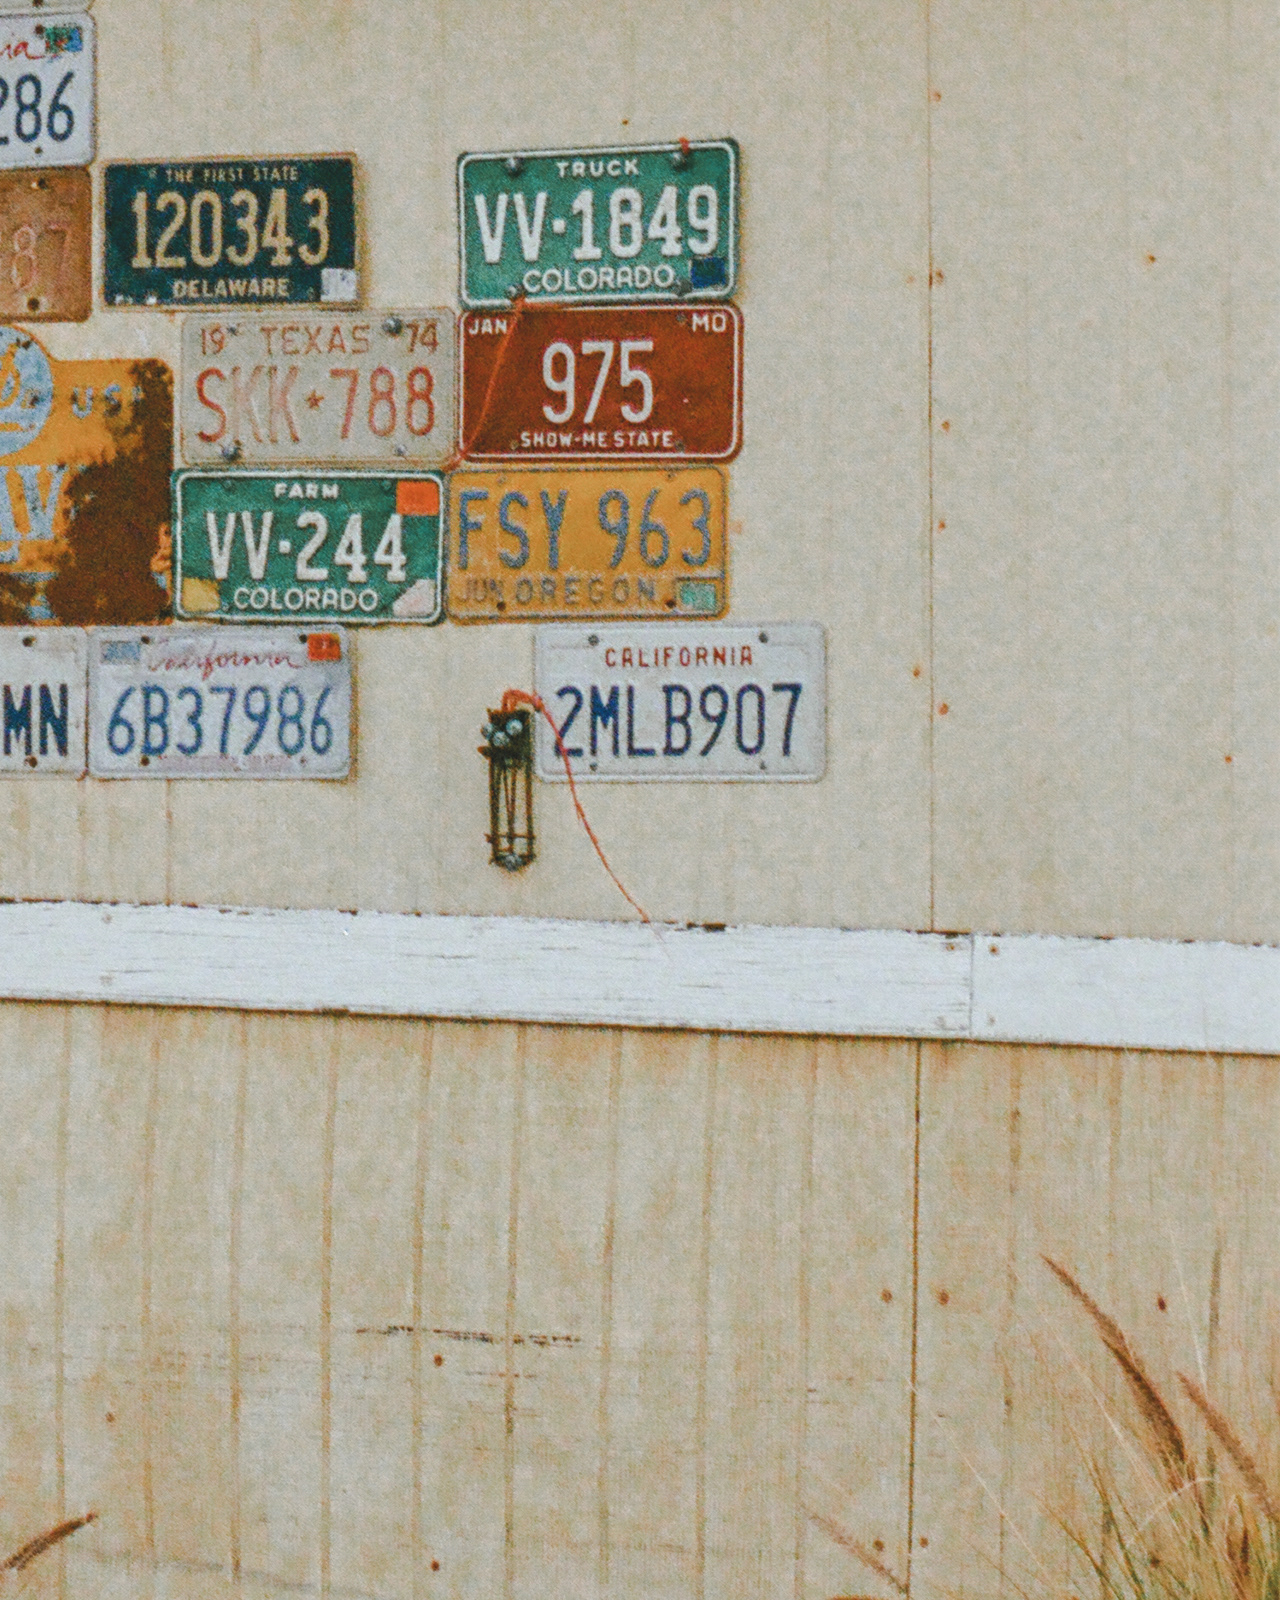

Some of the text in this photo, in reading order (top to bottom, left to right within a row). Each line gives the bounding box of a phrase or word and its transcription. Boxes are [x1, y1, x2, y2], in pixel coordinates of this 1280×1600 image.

[166, 166, 300, 184] THE FIRST STATE
[557, 157, 640, 179] TRUCK
[130, 186, 331, 269] 120343
[172, 277, 290, 299] DELAWARE
[522, 263, 676, 293] COLORADO
[199, 322, 440, 356] 19 TEXAS 74
[468, 312, 728, 336] JAN MO
[541, 338, 655, 426] 975
[194, 364, 437, 445] SKK 788
[520, 430, 675, 450] SHOW-ME STATE
[274, 482, 340, 500] FARM
[457, 487, 714, 571] FSY 963
[232, 587, 379, 612] COLORADO
[514, 575, 658, 606] OREGON
[605, 645, 755, 669] CALIFORNIA
[106, 684, 334, 757] 6B37986
[553, 683, 805, 759] 2MLB907
